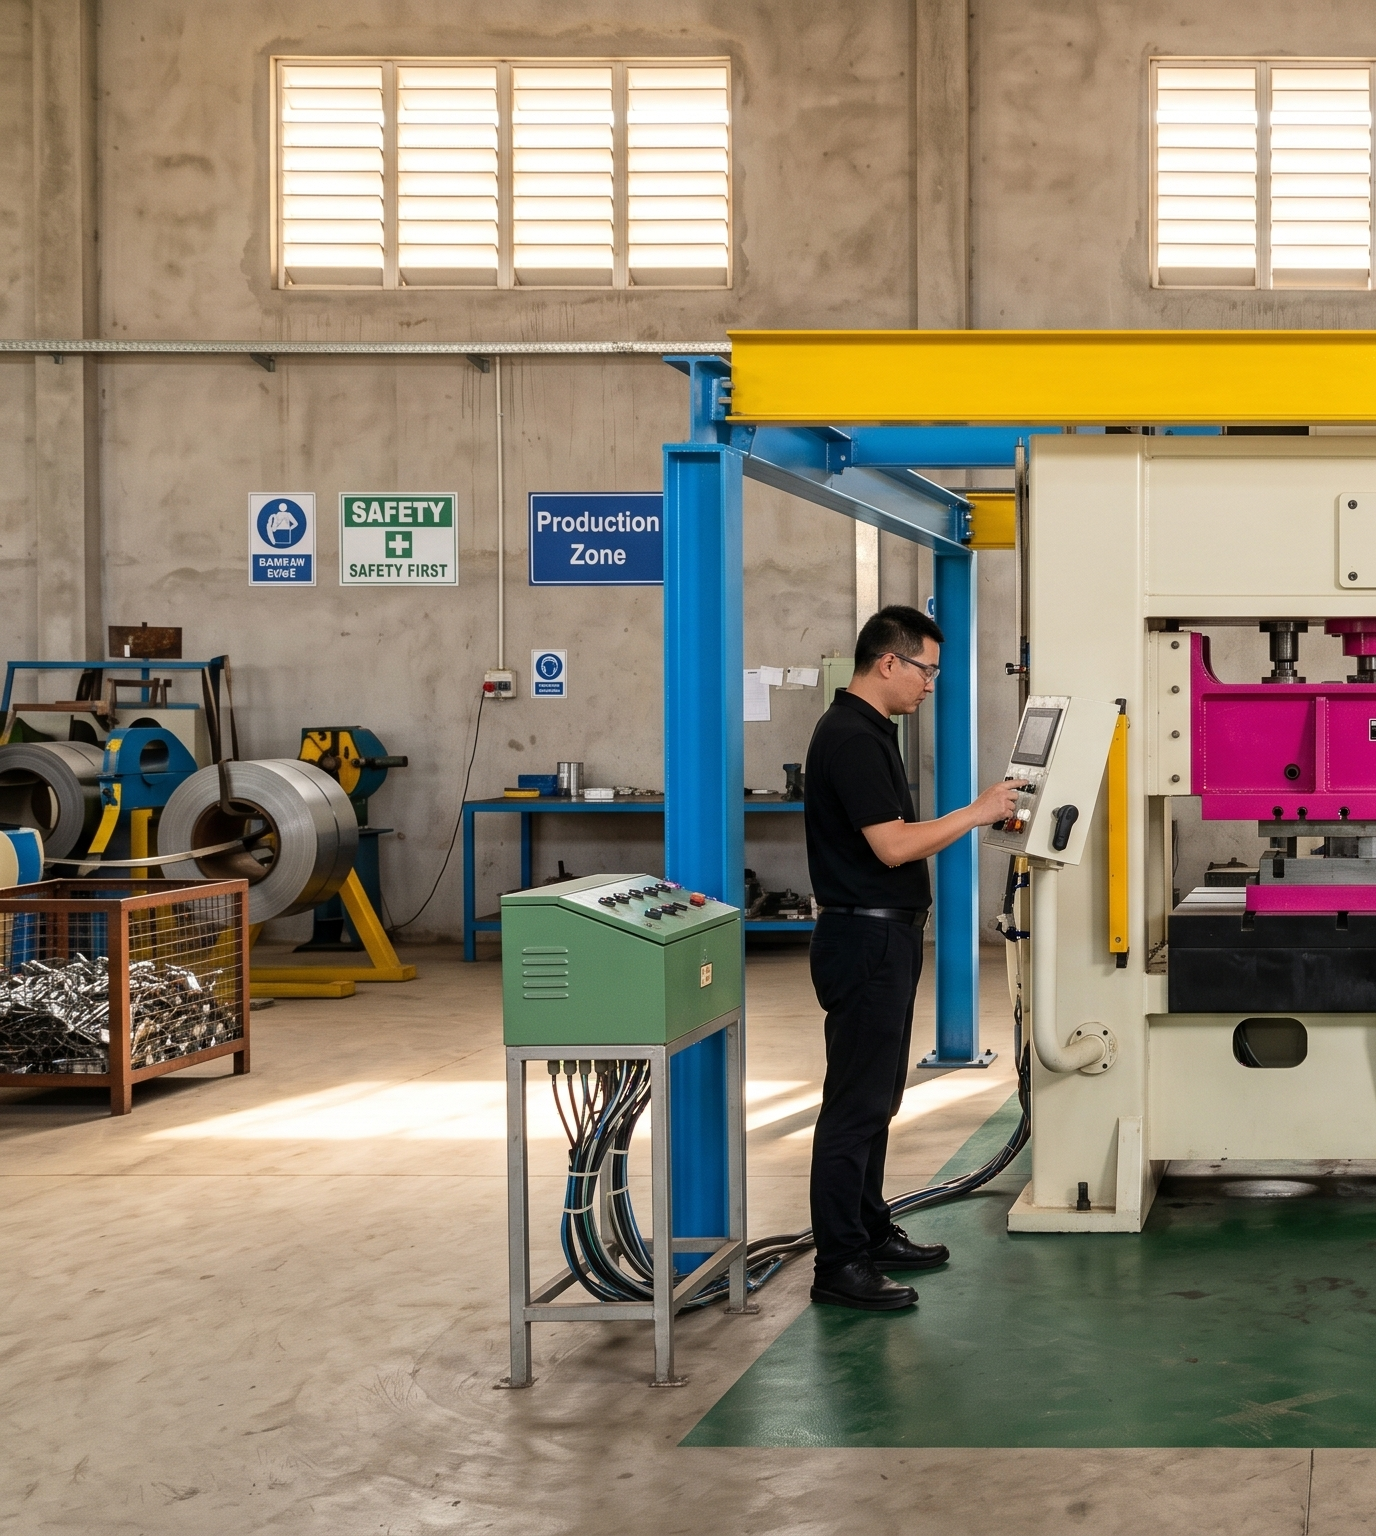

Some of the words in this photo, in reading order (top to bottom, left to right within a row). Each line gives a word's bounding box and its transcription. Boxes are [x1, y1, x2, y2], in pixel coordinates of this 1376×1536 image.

[352, 501, 445, 523] SAFETY
[537, 511, 660, 533] Production
[570, 543, 627, 565] Zone
[349, 563, 403, 578] SAFETY
[407, 563, 448, 578] FIRST
